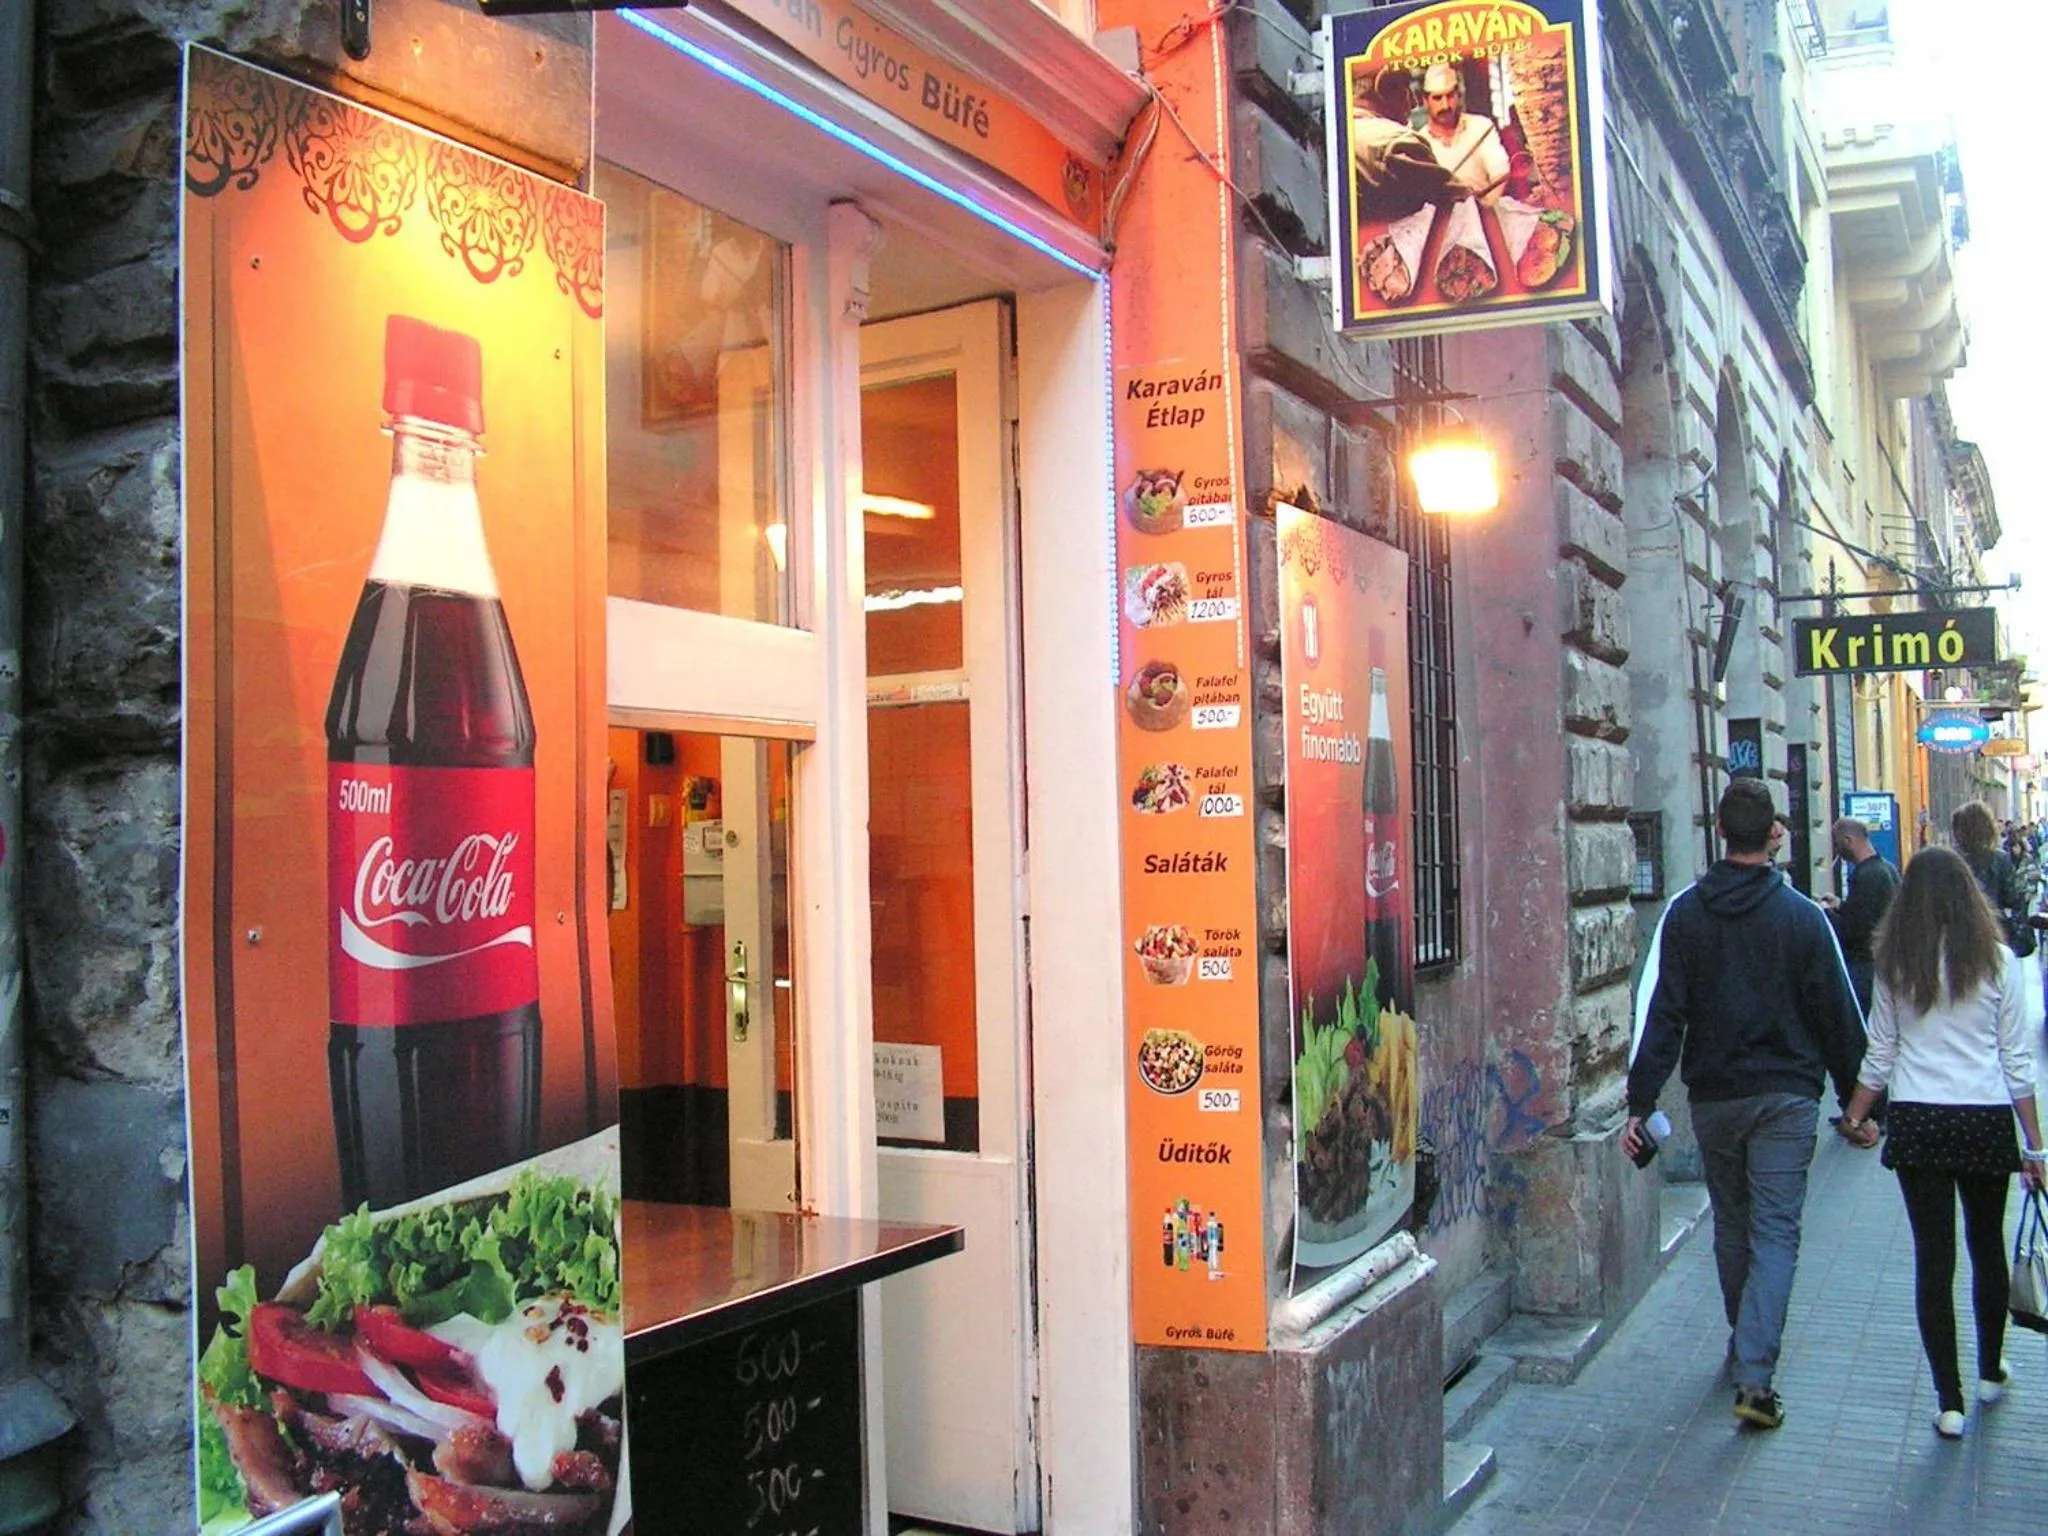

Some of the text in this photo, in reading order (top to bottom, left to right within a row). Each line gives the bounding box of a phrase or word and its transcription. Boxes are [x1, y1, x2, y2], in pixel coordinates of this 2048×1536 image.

[1382, 5, 1532, 59] KARAVÁN
[835, 14, 911, 92] Gyros
[921, 74, 990, 138] Büfé
[1127, 368, 1222, 400] Karaván
[1146, 402, 1206, 429] Étlap
[1193, 475, 1230, 491] Gyros
[1195, 570, 1233, 586] Gyros
[1810, 619, 1965, 670] Krimó
[1195, 674, 1238, 689] Falafel
[1300, 684, 1344, 725] Együtt
[1302, 725, 1361, 764] finomabb
[1194, 765, 1238, 779] Falafel
[339, 779, 393, 815] 500ml
[1208, 782, 1227, 795] tál
[1143, 851, 1228, 874] Saláták
[353, 831, 520, 928] Coca-Cola
[1204, 929, 1241, 941] Török
[1202, 945, 1243, 958] saláta
[1204, 1045, 1243, 1060] Görög
[1203, 1061, 1244, 1075] saláta
[1165, 1326, 1235, 1342] Gyros Büfé
